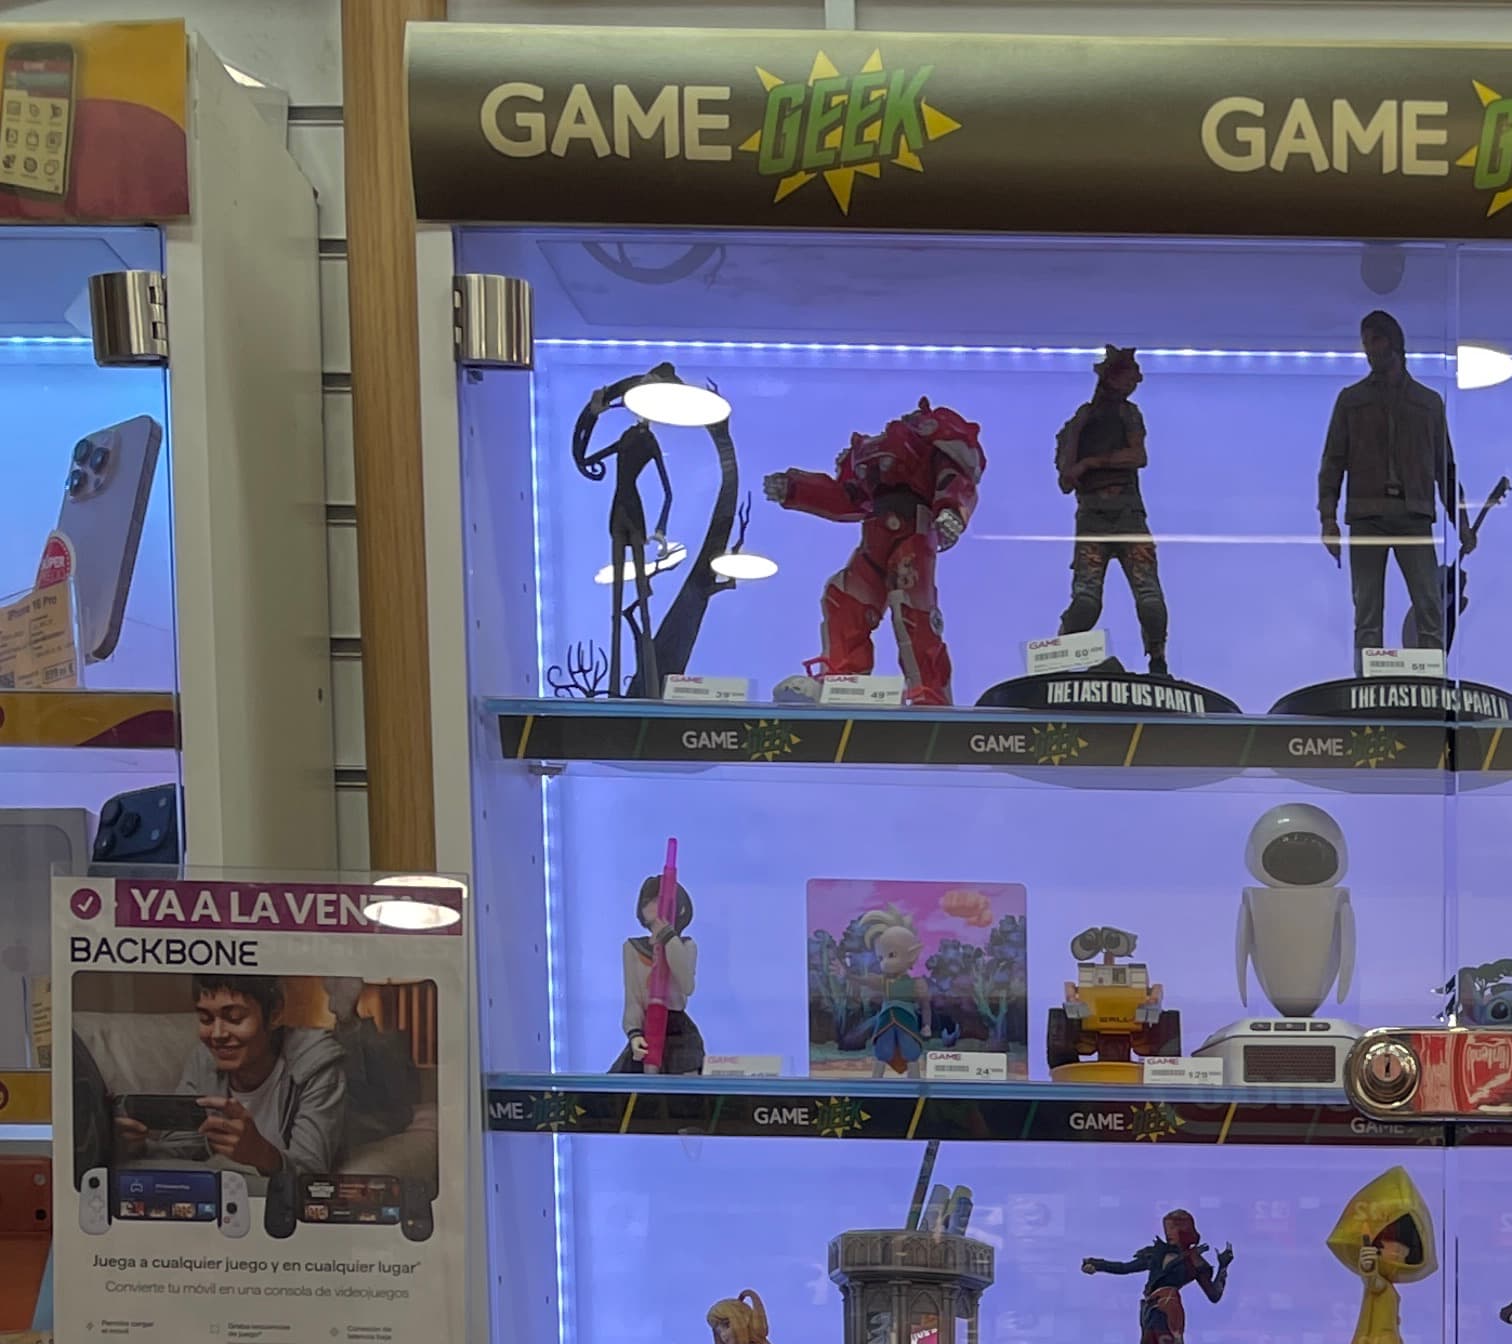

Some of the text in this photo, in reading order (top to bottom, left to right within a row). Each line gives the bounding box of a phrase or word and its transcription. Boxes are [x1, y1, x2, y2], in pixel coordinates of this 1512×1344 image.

[481, 64, 934, 176] GAME GEEK
[1201, 98, 1449, 176] GAME
[1029, 638, 1061, 650] GAME
[824, 675, 858, 684] GAME
[1047, 681, 1072, 703] THE
[1073, 681, 1110, 703] LAST
[1111, 682, 1130, 704] OF
[1131, 683, 1153, 706] US
[1154, 687, 1192, 712] PART
[682, 731, 738, 749] GAME
[1289, 738, 1343, 756] GAME
[131, 889, 192, 921] YA
[197, 890, 226, 923] A
[230, 891, 279, 924] LA
[70, 938, 258, 967] BACKBONE
[1069, 1112, 1124, 1130] GAME
[93, 1255, 136, 1271] Juega
[140, 1259, 149, 1268] a
[152, 1256, 222, 1273] cualquier
[224, 1258, 267, 1273] juego
[272, 1262, 280, 1273] y
[283, 1261, 301, 1272] en
[305, 1260, 374, 1276] cualquier
[105, 1281, 165, 1294] Convierte
